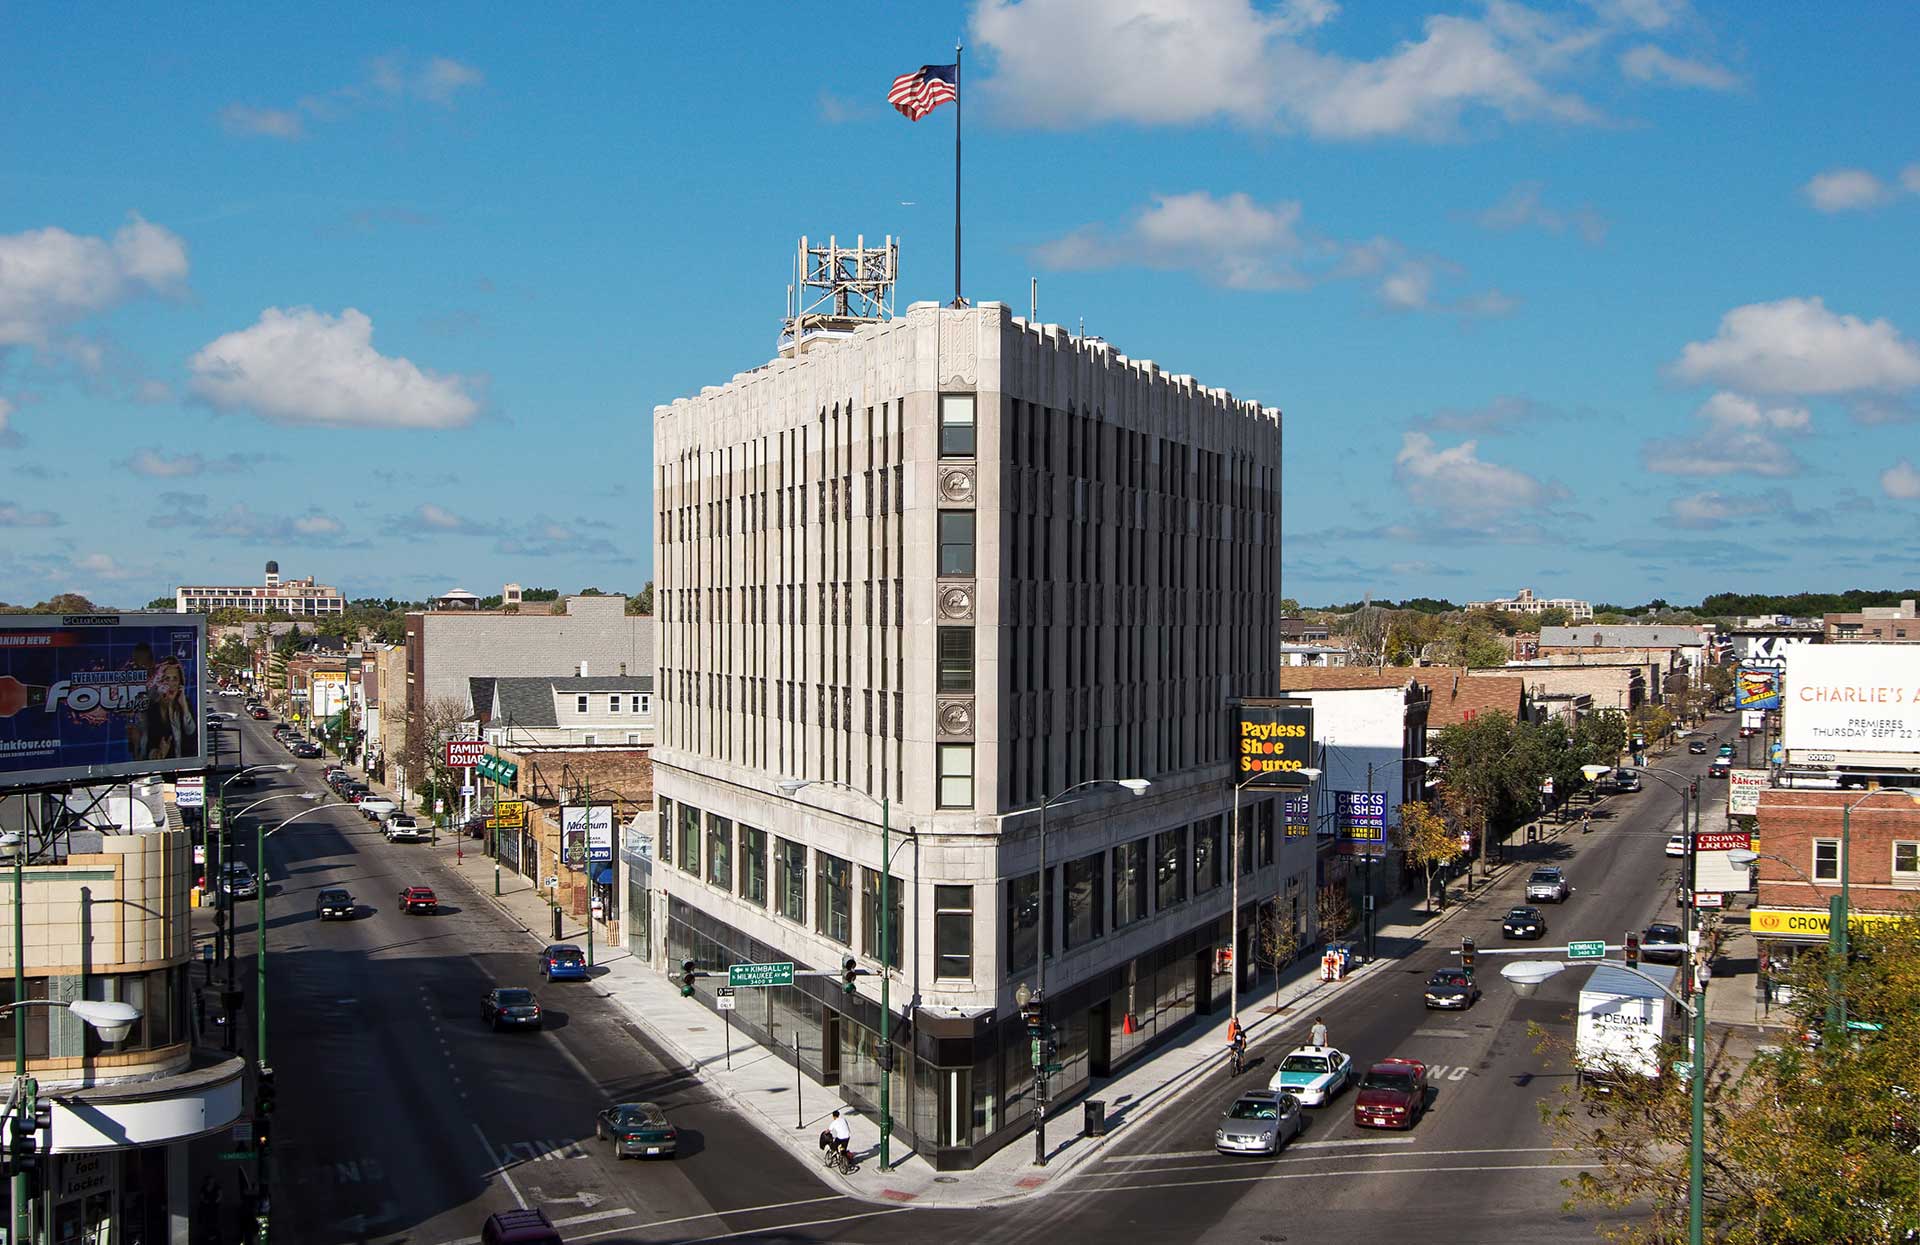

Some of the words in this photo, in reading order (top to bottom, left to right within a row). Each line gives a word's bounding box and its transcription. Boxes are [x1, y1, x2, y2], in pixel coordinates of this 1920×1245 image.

[26, 635, 51, 645] NEWS
[45, 681, 147, 713] four
[1800, 687, 1903, 703] CHARLIE'S
[1241, 721, 1306, 740] Payless
[1848, 719, 1904, 729] PREMIERES
[1813, 728, 1868, 737] THURSDAY
[1871, 729, 1896, 738] SEPT
[1899, 730, 1913, 738] 22
[450, 744, 484, 754] FAMILY
[1241, 739, 1284, 754] Shoe
[1241, 756, 1302, 772] Source
[1339, 794, 1384, 804] CHECKS
[1339, 805, 1383, 815] CASHED
[1788, 917, 1831, 930] CROW
[1604, 1012, 1648, 1026] DEMAR
